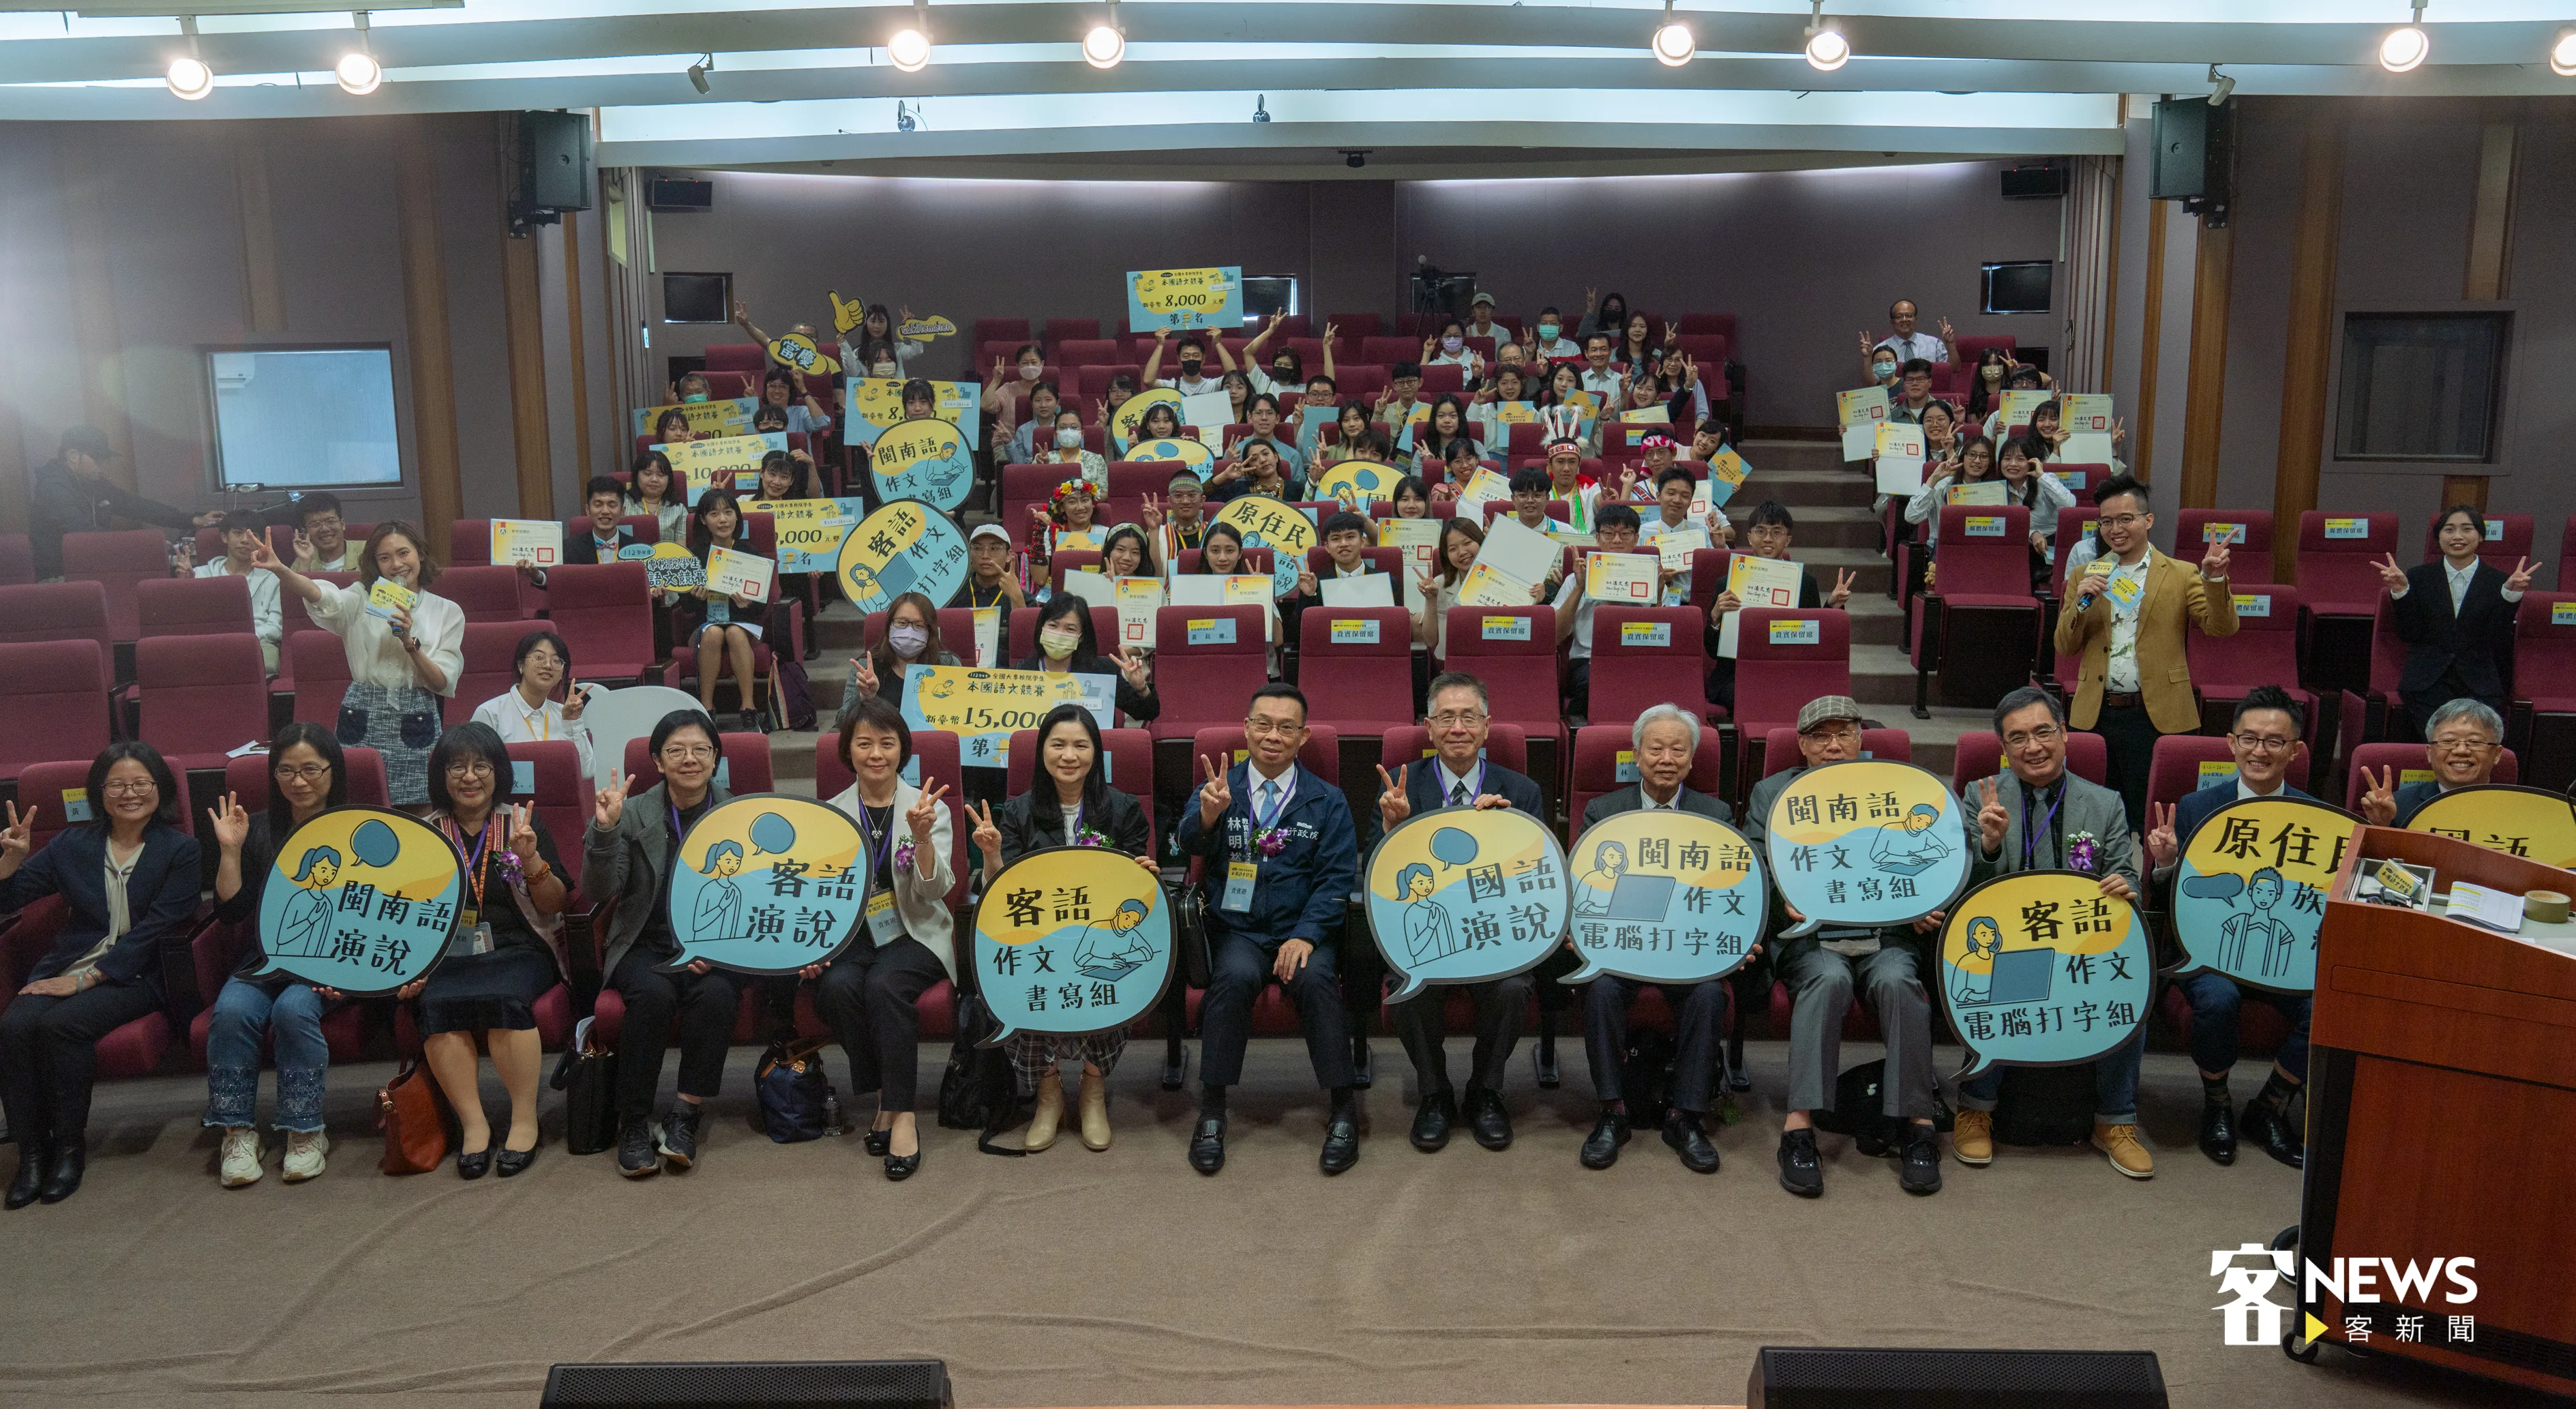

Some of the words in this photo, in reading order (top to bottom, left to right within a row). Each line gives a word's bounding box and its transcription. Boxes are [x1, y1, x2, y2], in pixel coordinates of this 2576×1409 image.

[1161, 278, 1204, 286] 本國語文競賽
[1165, 294, 1206, 307] 8,000
[1169, 312, 1203, 325] 第三名
[687, 411, 718, 421] 語文競賽
[1121, 409, 1146, 429] 客
[691, 446, 743, 458] 本國語文競賽
[878, 436, 938, 465] 閩南語
[886, 473, 918, 492] 作文
[774, 510, 813, 519] 語文競賽
[1231, 501, 1306, 549] 原住民
[867, 507, 918, 558] 客語
[910, 525, 946, 559] 作文
[648, 569, 708, 587] 語文競賽
[915, 545, 967, 594] 打字組
[1274, 573, 1293, 591] 說
[1337, 630, 1374, 638] 貴賓保留席
[1488, 627, 1525, 635] 貴賓保留席
[1627, 633, 1665, 641] 貴賓保留席
[967, 681, 1045, 697] 本國語文競賽
[993, 672, 1045, 682] 全國大專校院學生
[925, 714, 960, 726] 新臺幣
[1786, 792, 1900, 825] 閩南語
[1638, 837, 1752, 872] 閩南語
[1790, 844, 1853, 872] 作文
[767, 858, 857, 901] 客語
[1465, 855, 1557, 904] 國語
[1824, 876, 1920, 904] 書寫組
[338, 880, 452, 932] 閩南語
[1003, 885, 1092, 928] 客語
[1683, 887, 1746, 917] 作文
[747, 904, 835, 949] 演說
[1461, 902, 1555, 951] 演說
[2019, 897, 2112, 942] 客語
[331, 928, 413, 975] 演說
[1580, 922, 1747, 957] 電腦打字組
[993, 945, 1056, 976] 作文
[2065, 951, 2133, 985] 作文
[1025, 981, 1120, 1011] 書寫組
[1963, 1000, 2138, 1041] 電腦打字組
